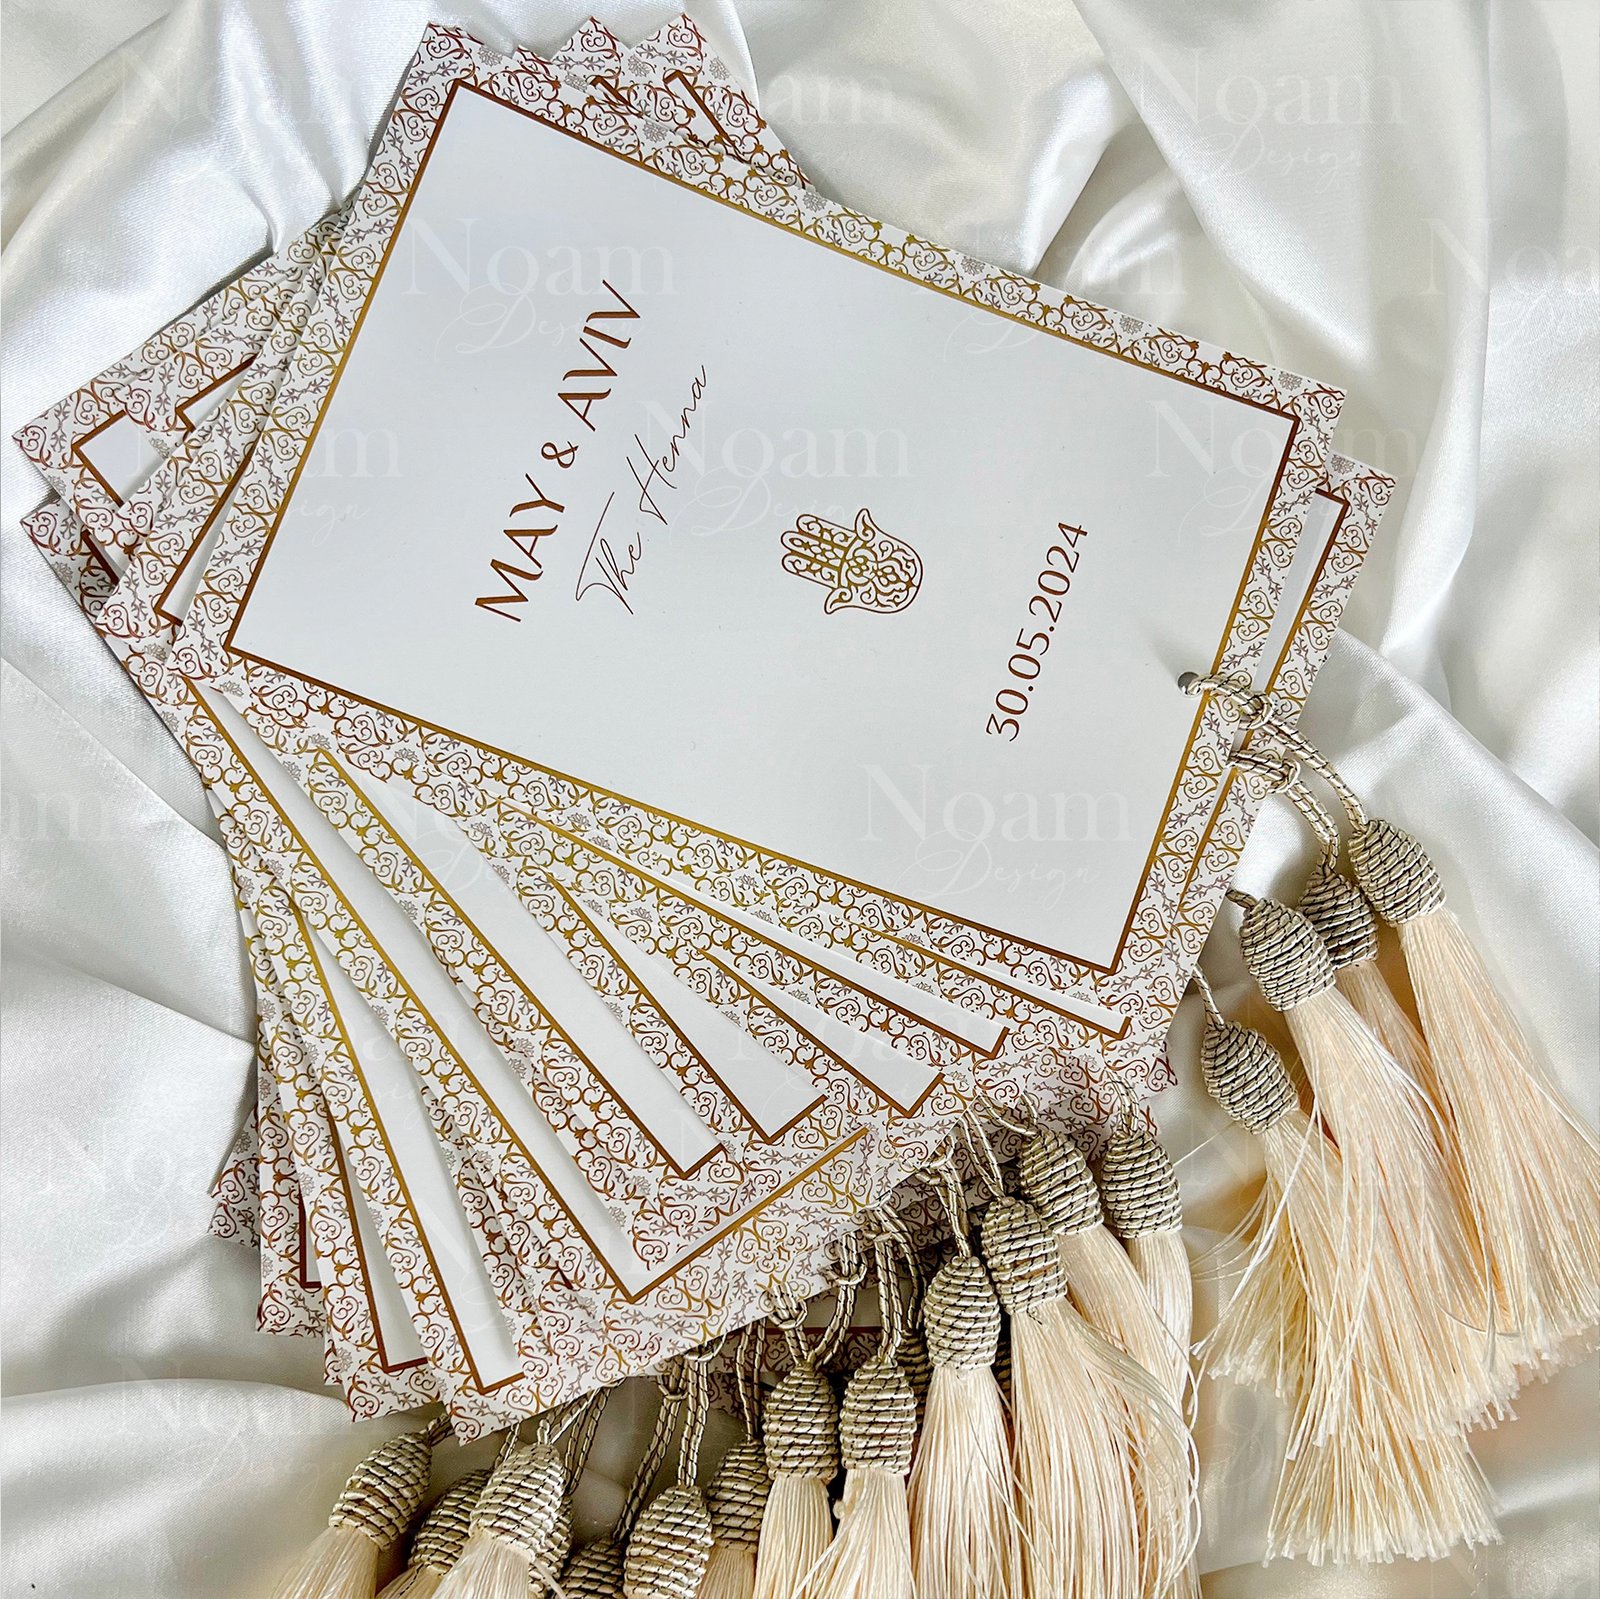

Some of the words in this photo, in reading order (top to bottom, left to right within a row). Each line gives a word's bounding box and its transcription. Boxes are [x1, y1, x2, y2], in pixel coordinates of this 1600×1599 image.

[558, 280, 640, 431] AVIV
[541, 441, 579, 469] &
[576, 492, 641, 615] The
[626, 365, 706, 525] Henna
[475, 473, 565, 622] MAY
[986, 523, 1087, 741] 30.05.2024
